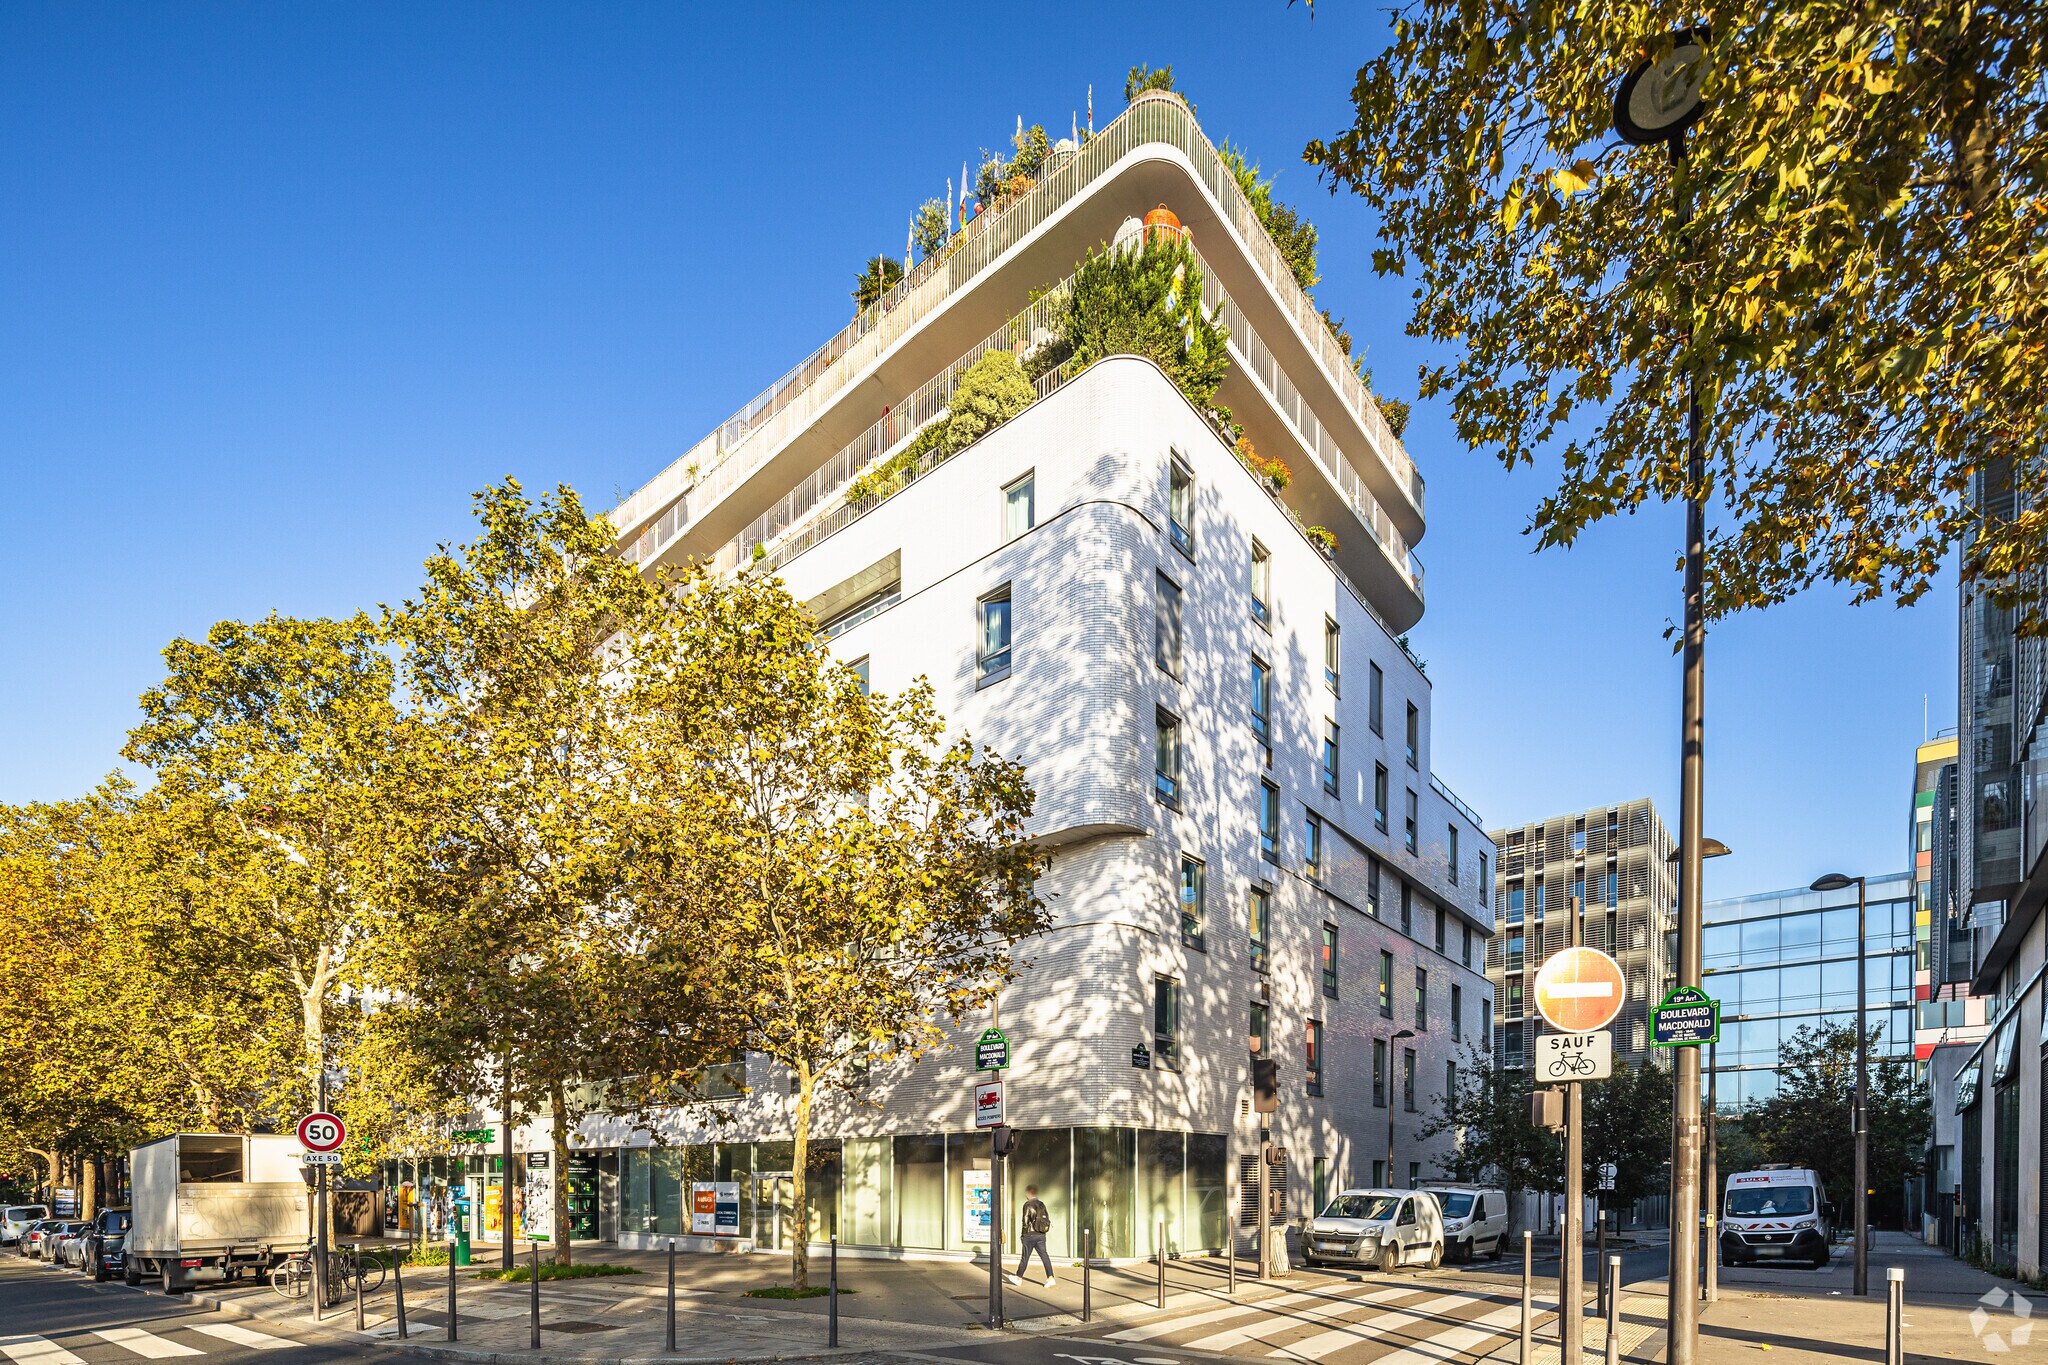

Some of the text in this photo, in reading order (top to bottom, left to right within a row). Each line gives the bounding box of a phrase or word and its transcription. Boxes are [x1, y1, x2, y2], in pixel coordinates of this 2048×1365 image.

[1660, 1007, 1709, 1019] BOULEVARD
[1658, 1019, 1710, 1031] MACDONALD
[981, 1043, 1004, 1051] BOULEVARD
[1551, 1036, 1595, 1049] SAUF
[980, 1051, 1005, 1060] MACDONALD
[309, 1125, 335, 1140] 50
